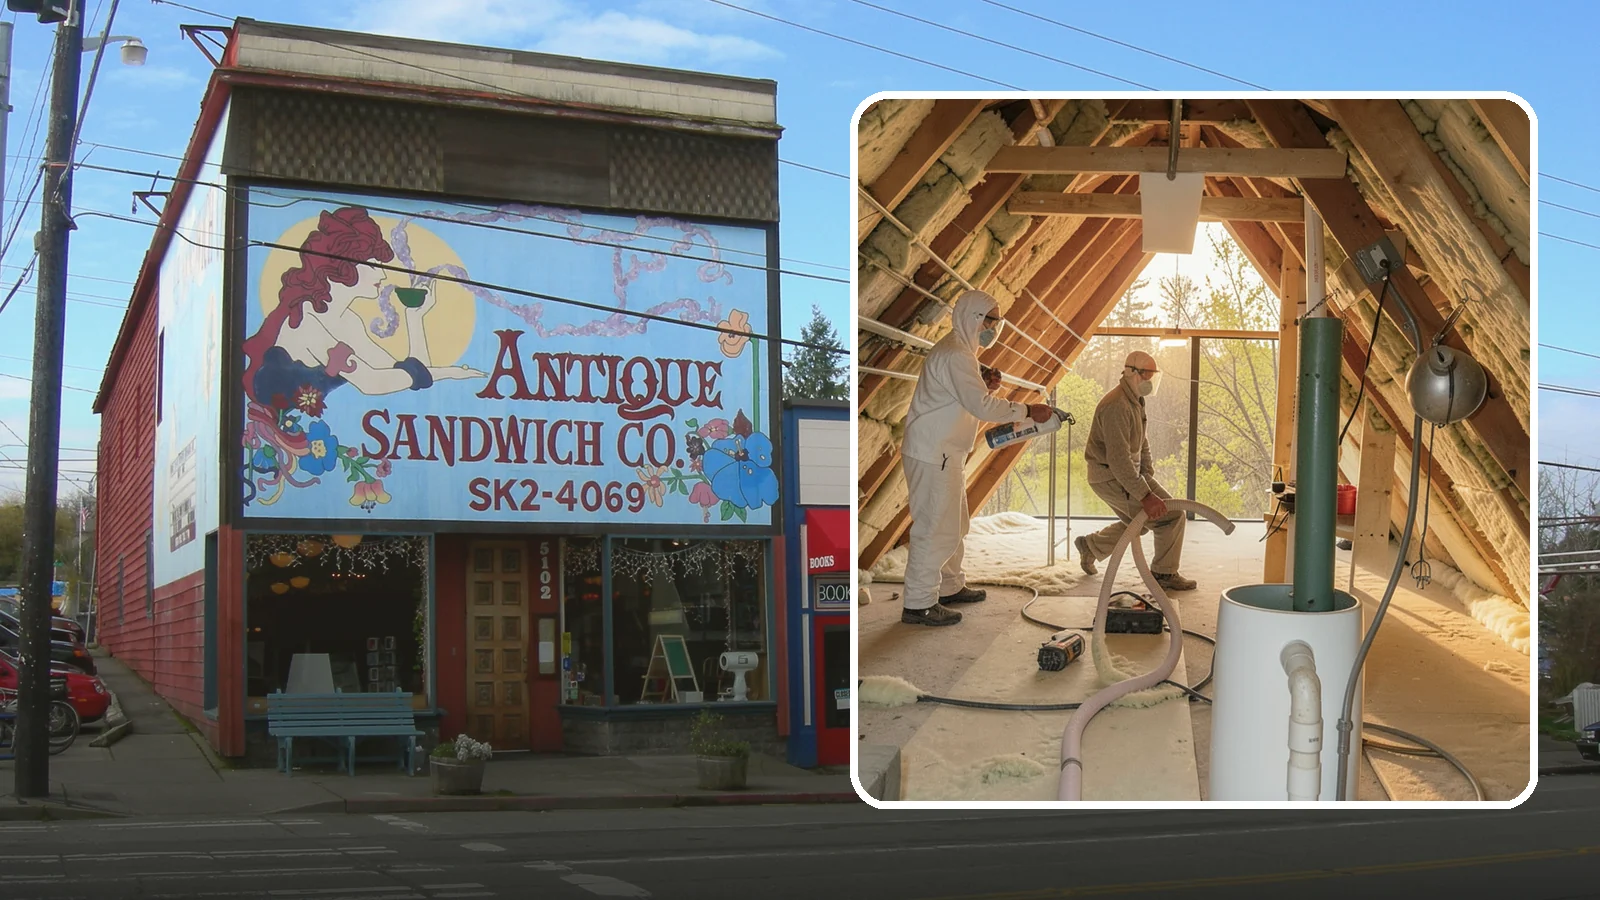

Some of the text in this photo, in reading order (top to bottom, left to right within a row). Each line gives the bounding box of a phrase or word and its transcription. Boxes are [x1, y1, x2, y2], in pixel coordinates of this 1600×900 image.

[362, 409, 684, 468] SANDWICH CO.
[468, 477, 646, 512] SK2-4069
[540, 542, 551, 599] 5102
[809, 556, 834, 568] BOOKS
